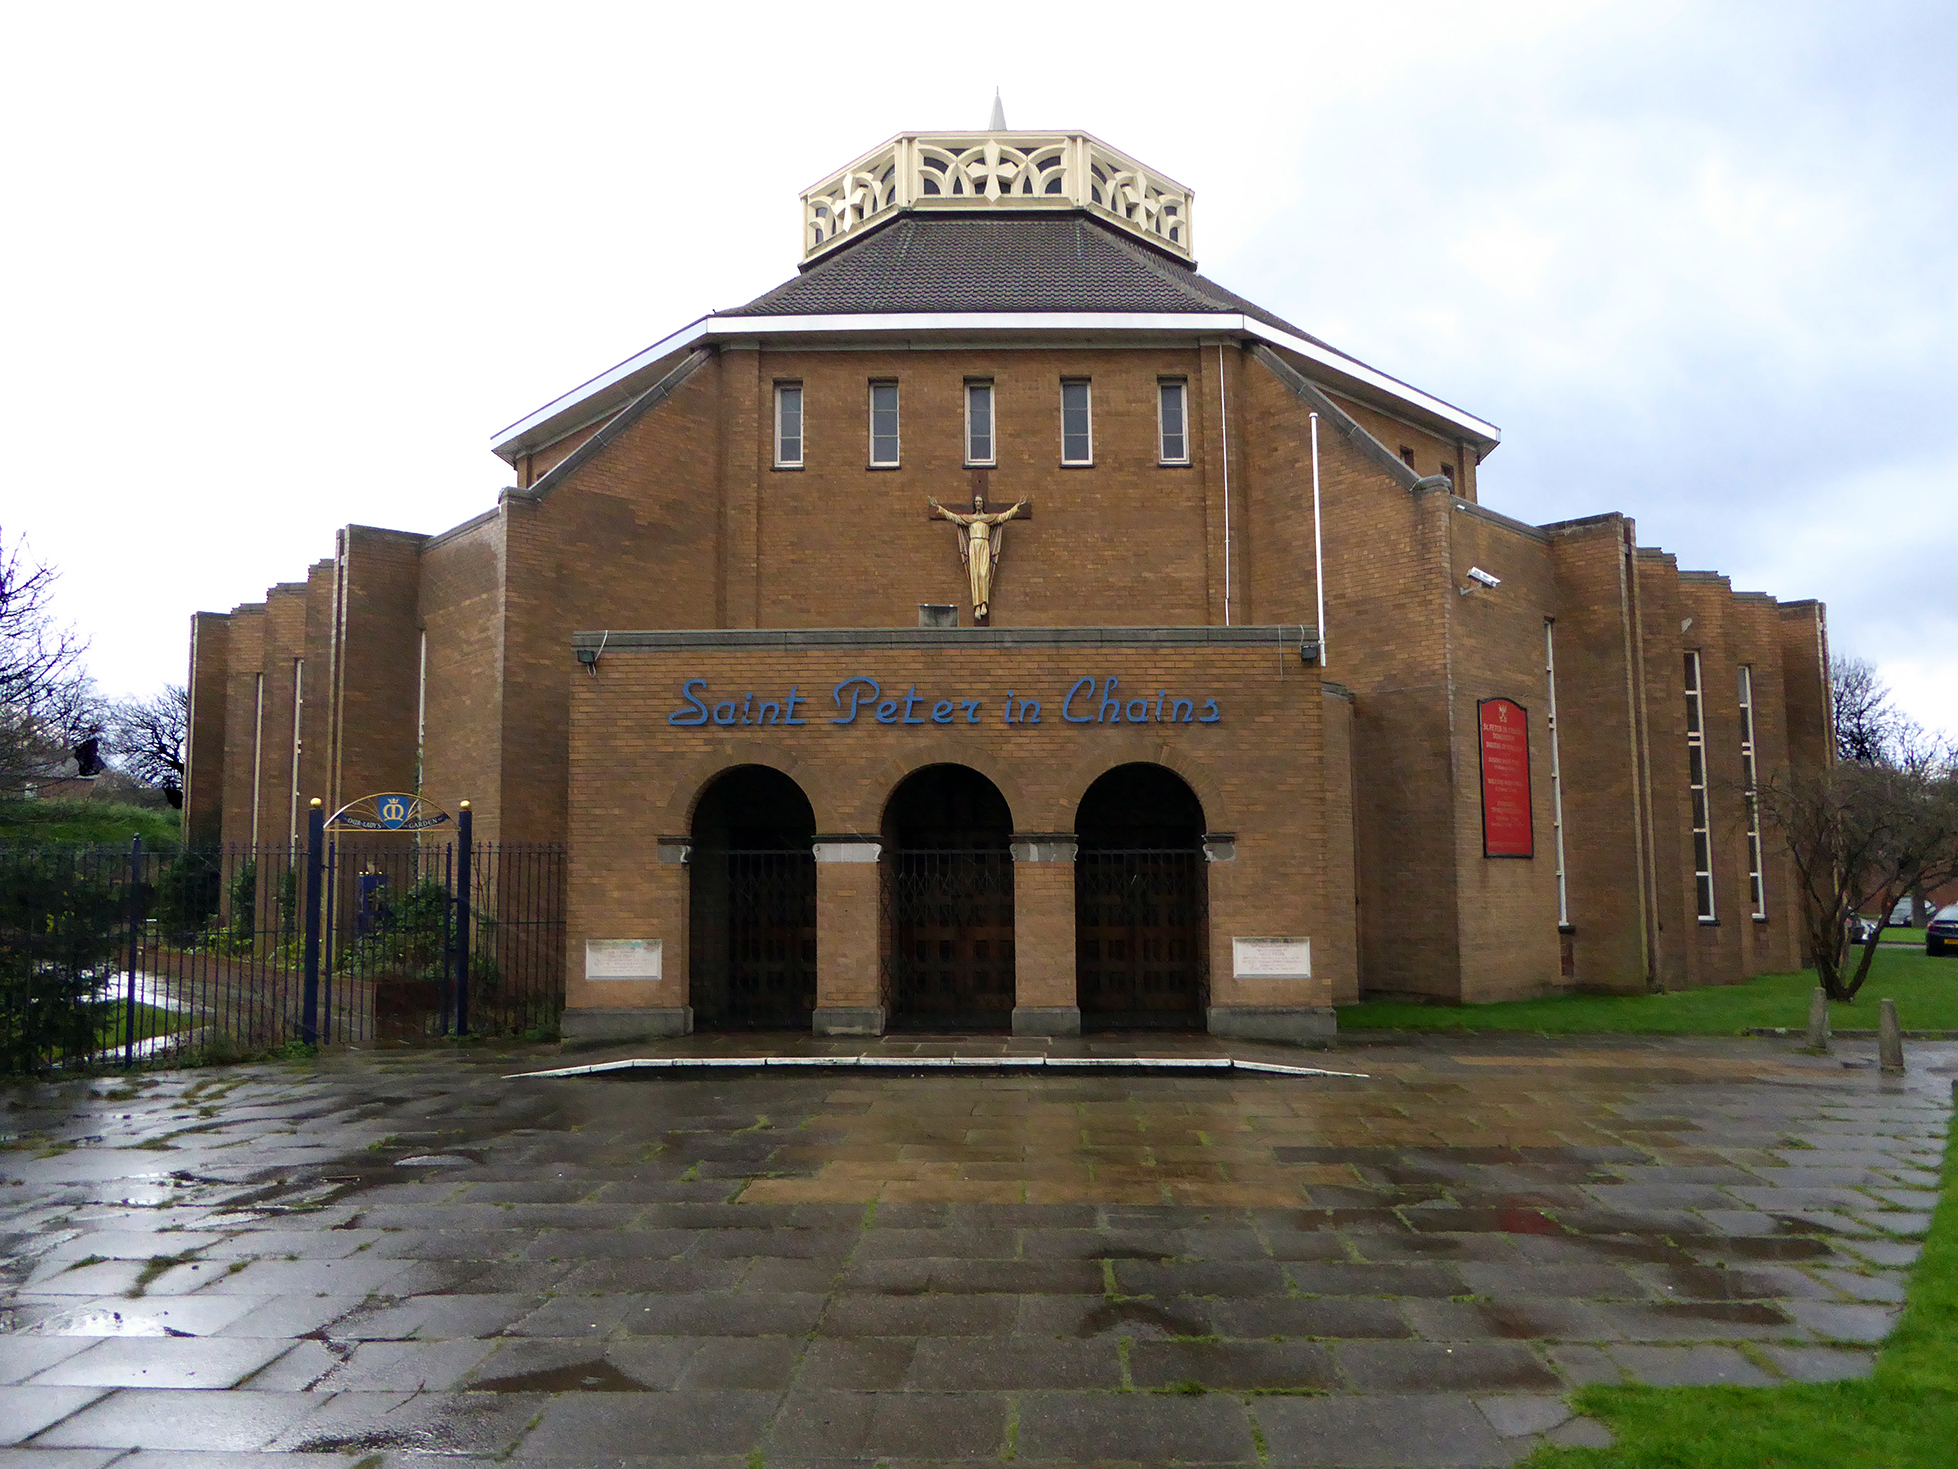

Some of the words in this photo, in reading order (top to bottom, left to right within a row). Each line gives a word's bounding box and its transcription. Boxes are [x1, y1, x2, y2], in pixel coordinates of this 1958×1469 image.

[667, 678, 807, 727] Saint
[829, 675, 982, 725] Peter
[1004, 688, 1042, 725] in
[1062, 675, 1221, 725] Chains
[408, 818, 438, 829] GARDEN
